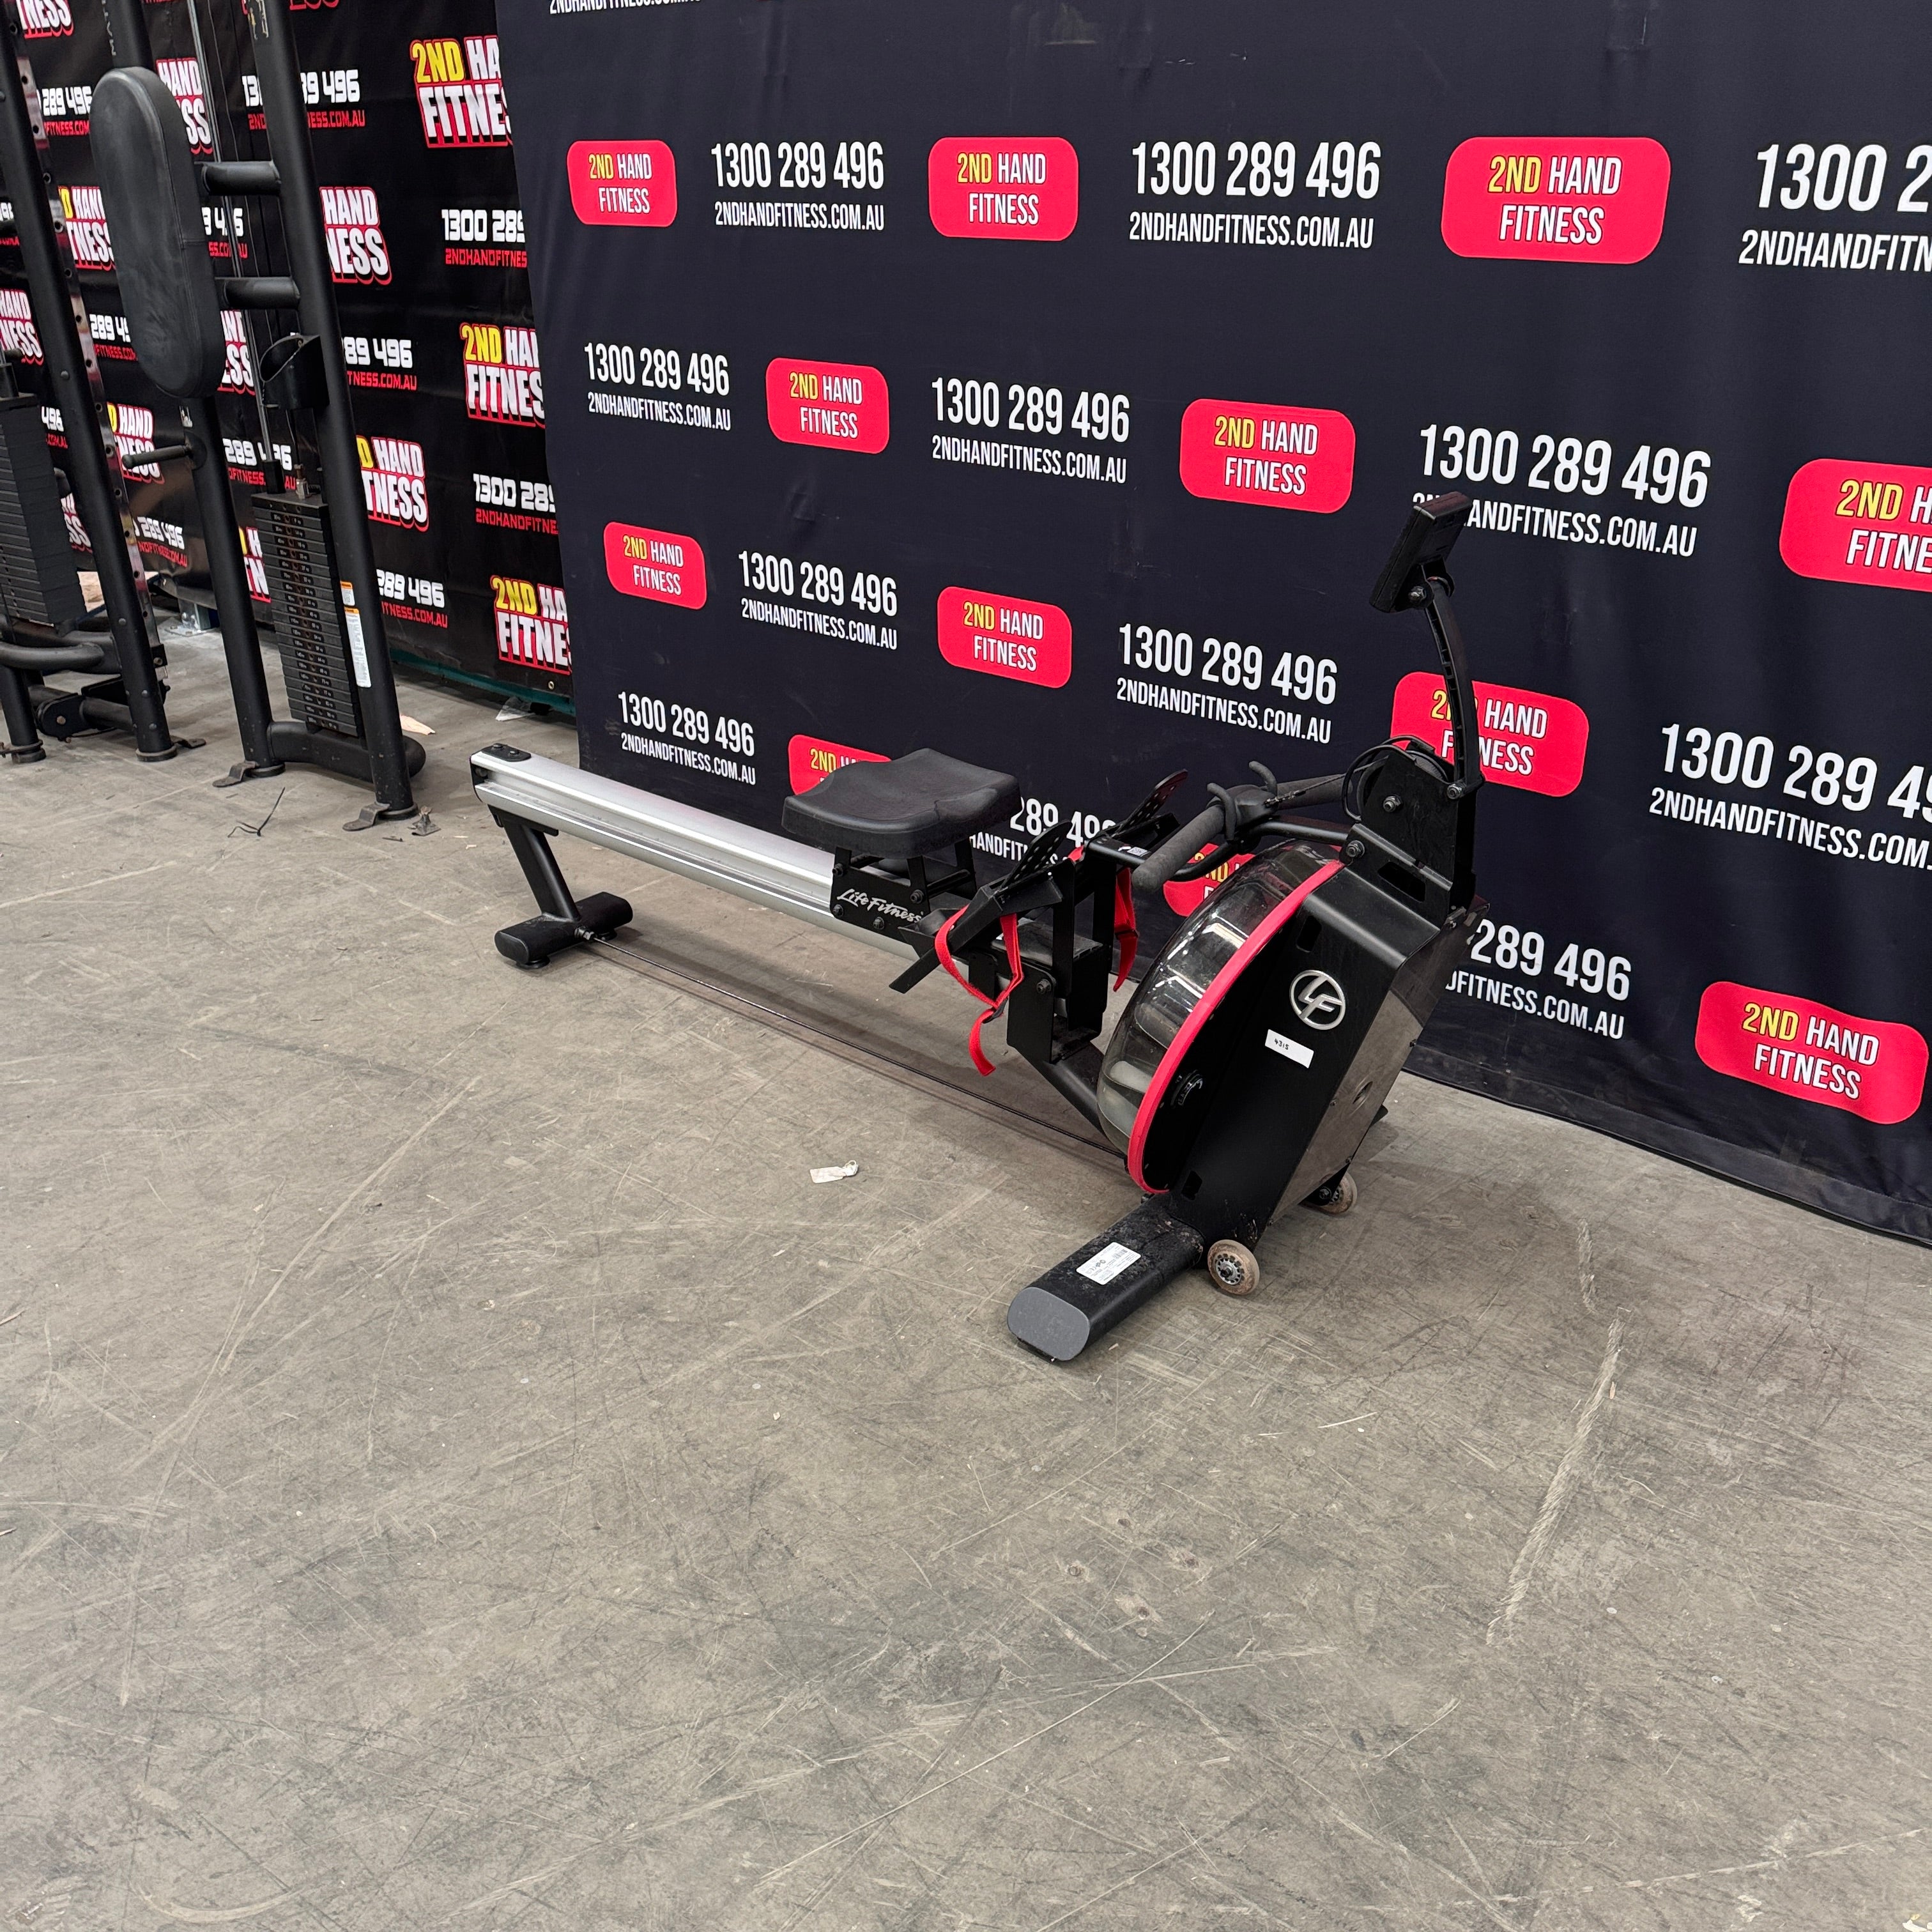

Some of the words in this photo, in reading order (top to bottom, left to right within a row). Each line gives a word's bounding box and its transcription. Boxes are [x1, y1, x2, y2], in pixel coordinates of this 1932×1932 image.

[413, 42, 464, 82] 2ND
[42, 88, 66, 116] 289
[322, 70, 360, 103] 496
[589, 155, 613, 178] 2ND
[617, 154, 652, 179] HAND
[711, 142, 771, 187] 1300
[778, 142, 825, 188] 289
[834, 142, 884, 189] 496
[958, 153, 992, 183] 2ND
[999, 153, 1045, 183] HAND
[1133, 142, 1215, 195] 1300
[1226, 142, 1295, 197] 289
[1306, 142, 1381, 199] 496
[1489, 157, 1541, 192] 2ND
[1549, 157, 1621, 194] HAND
[1758, 144, 1887, 211] 1300
[321, 190, 378, 225] HAND
[599, 188, 650, 213] FITNESS
[715, 201, 884, 230] 2NDHANDFITNESS.COM.AU
[970, 194, 1038, 224] FITNESS
[441, 210, 487, 241] 1300
[1130, 211, 1374, 248] 2NDHANDFITNESS.COM.AU
[1500, 205, 1604, 243] FITNESS
[89, 314, 115, 341] 289
[462, 325, 502, 363] 2ND
[341, 336, 371, 365] 89
[373, 339, 412, 368] 496
[585, 342, 635, 385] 1300
[640, 348, 680, 390] 289
[687, 353, 729, 395] 496
[790, 372, 818, 399] 2ND
[823, 376, 862, 404] HAND
[119, 406, 153, 439] HAND
[588, 392, 730, 431] 2NDHANDFITNESS.COM.AU
[801, 407, 857, 438] FITNESS
[932, 378, 999, 427] 1300
[1009, 385, 1062, 434] 289
[1071, 392, 1129, 442] 496
[223, 438, 257, 466] 289
[1215, 417, 1254, 448] 2ND
[1262, 420, 1317, 454] HAND
[373, 440, 424, 478] HAND
[933, 435, 1128, 483] 2NDHANDFITNESS.COM.AU
[1225, 457, 1306, 494] FITNESS
[1421, 424, 1519, 484] 1300
[1528, 435, 1611, 495] 289
[1621, 445, 1710, 507] 496
[473, 473, 516, 507] 1300
[1837, 480, 1903, 519] 2ND
[161, 521, 185, 550] 496
[1413, 493, 1698, 557] ANDFITNESS.COM.AU
[624, 535, 647, 559] 2ND
[650, 540, 683, 567] HAND
[408, 578, 444, 608] 496
[493, 578, 537, 615] 2ND
[634, 565, 681, 595] FITNESS
[739, 551, 793, 595] 1300
[801, 562, 844, 605] 289
[851, 572, 896, 616] 496
[742, 597, 896, 650] 2NDHANDFITNESS.COM.AU
[964, 602, 994, 629] 2ND
[1000, 609, 1043, 639] HAND
[974, 634, 1036, 671] FITNESS
[1119, 624, 1192, 676] 1300
[1202, 638, 1262, 690] 289
[1271, 652, 1337, 704] 496
[618, 692, 666, 732] 1300
[671, 704, 709, 744] 289
[715, 717, 754, 756] 496
[1117, 677, 1331, 743] 2NDHANDFITNESS.COM.AU
[1485, 700, 1547, 738] HAND
[622, 732, 755, 785] 2NDHANDFITNESS.COM.AU
[809, 747, 836, 773] 2ND
[1441, 730, 1534, 774] FNESS
[1662, 724, 1774, 788] 1300
[1783, 746, 1877, 811] 289
[1066, 811, 1116, 847] 49
[837, 889, 869, 907] Life
[867, 898, 922, 923] Fitness
[1470, 919, 1545, 976] 289
[1554, 944, 1630, 1000] 496
[1274, 1038, 1289, 1050] 4315
[1743, 1004, 1798, 1040] 2ND
[1806, 1016, 1878, 1066] HAND
[1755, 1043, 1860, 1098] FITNESS
